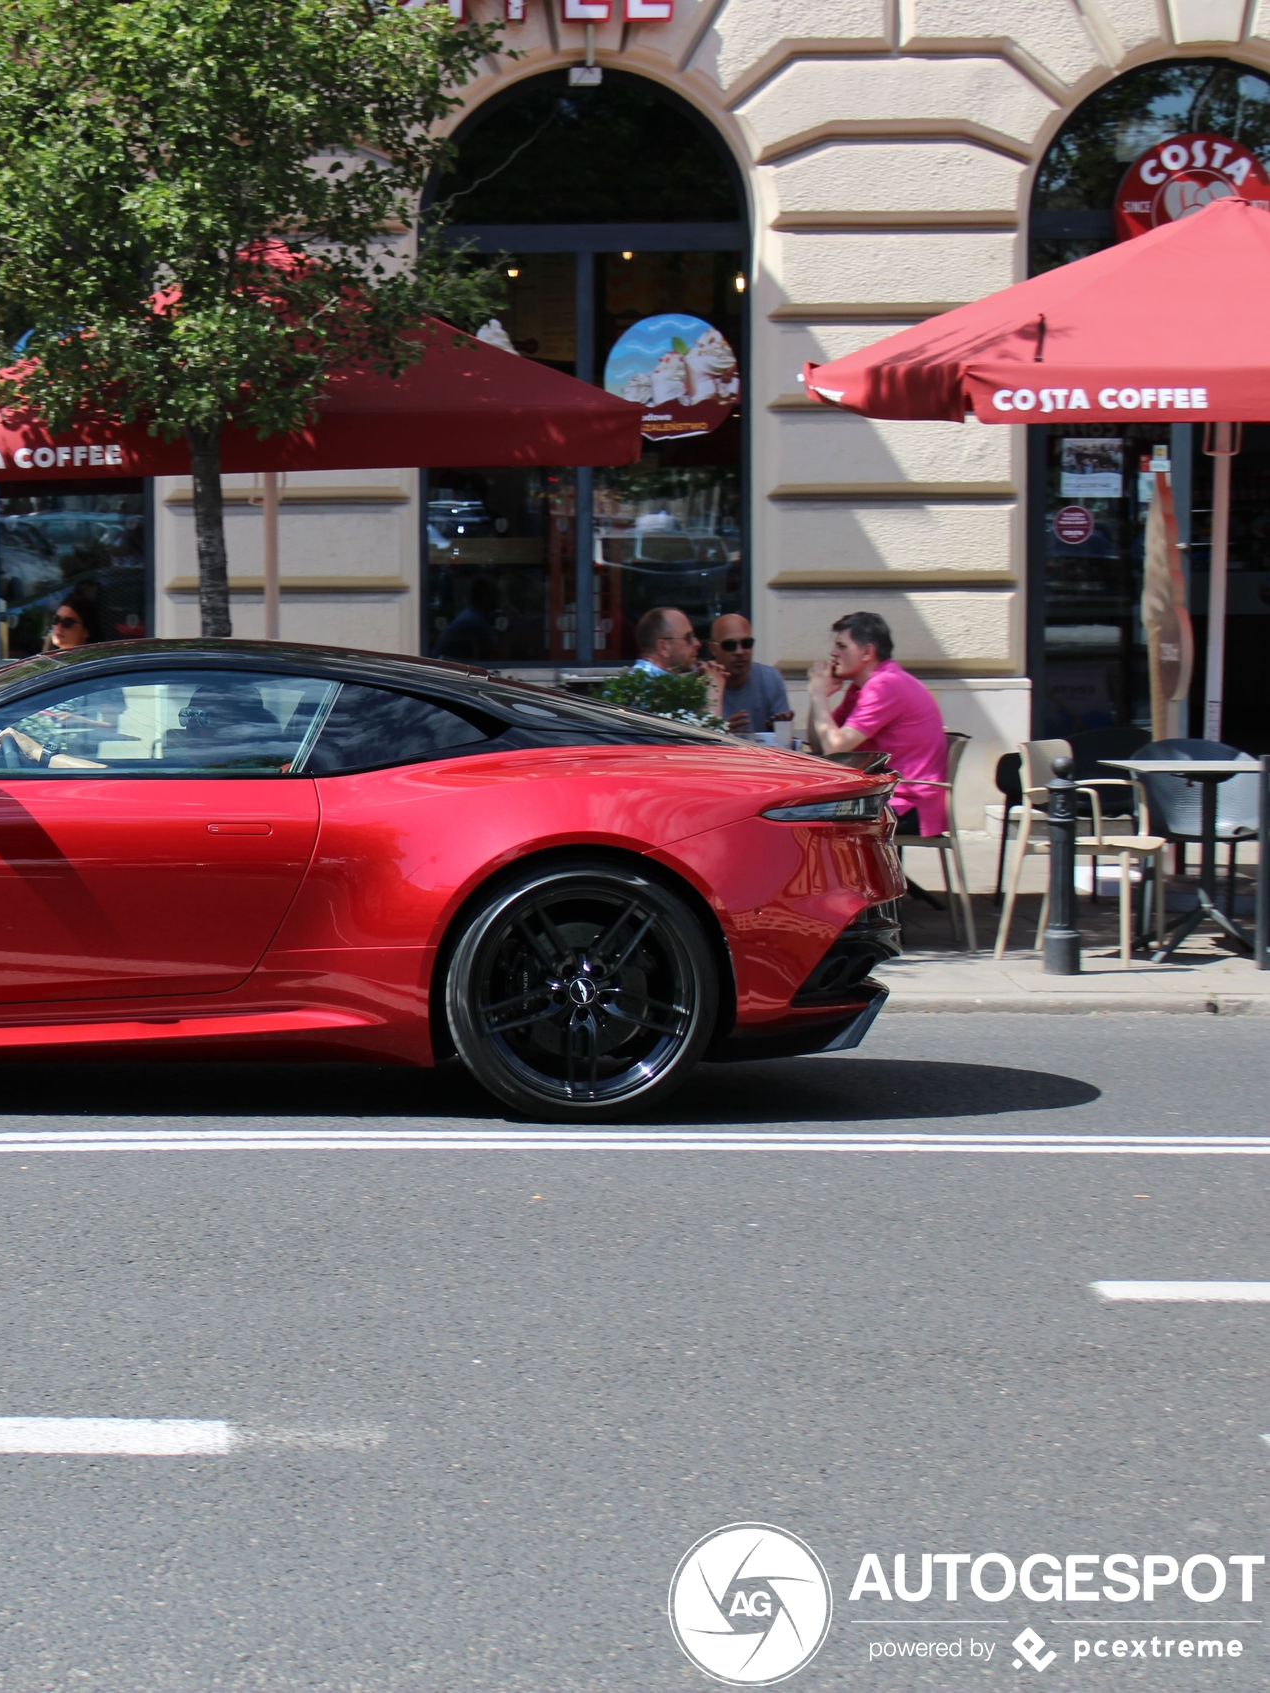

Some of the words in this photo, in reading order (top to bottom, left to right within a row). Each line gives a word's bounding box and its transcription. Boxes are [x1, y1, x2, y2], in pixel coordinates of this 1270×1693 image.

[1140, 140, 1252, 186] COSTA
[1123, 201, 1151, 213] SINCE
[992, 388, 1091, 413] COSTA
[1097, 388, 1209, 410] COFFEE
[13, 444, 124, 469] COFFEE
